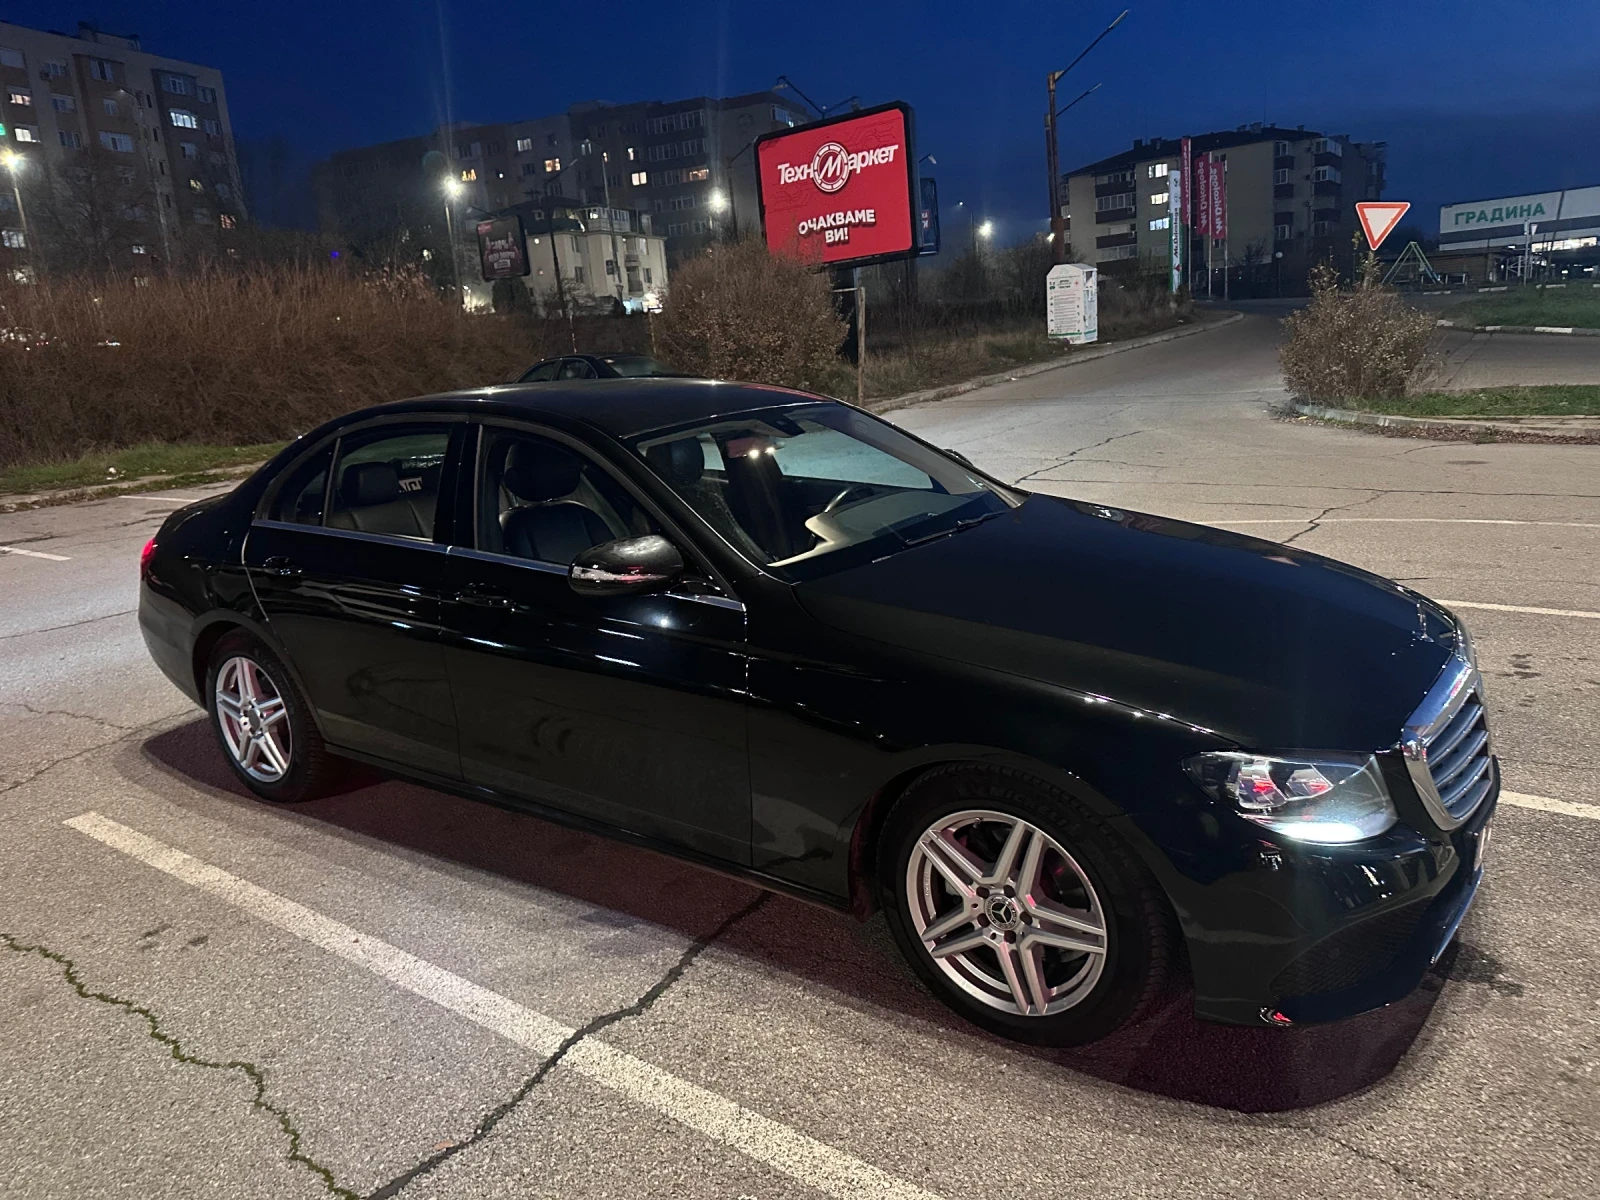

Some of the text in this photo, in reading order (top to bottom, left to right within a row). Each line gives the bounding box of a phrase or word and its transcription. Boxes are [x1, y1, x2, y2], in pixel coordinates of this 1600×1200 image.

[798, 209, 875, 235] ОЧАКВАМЕ
[1454, 202, 1546, 225] ГРАДИНА
[825, 227, 849, 243] ВИ!
